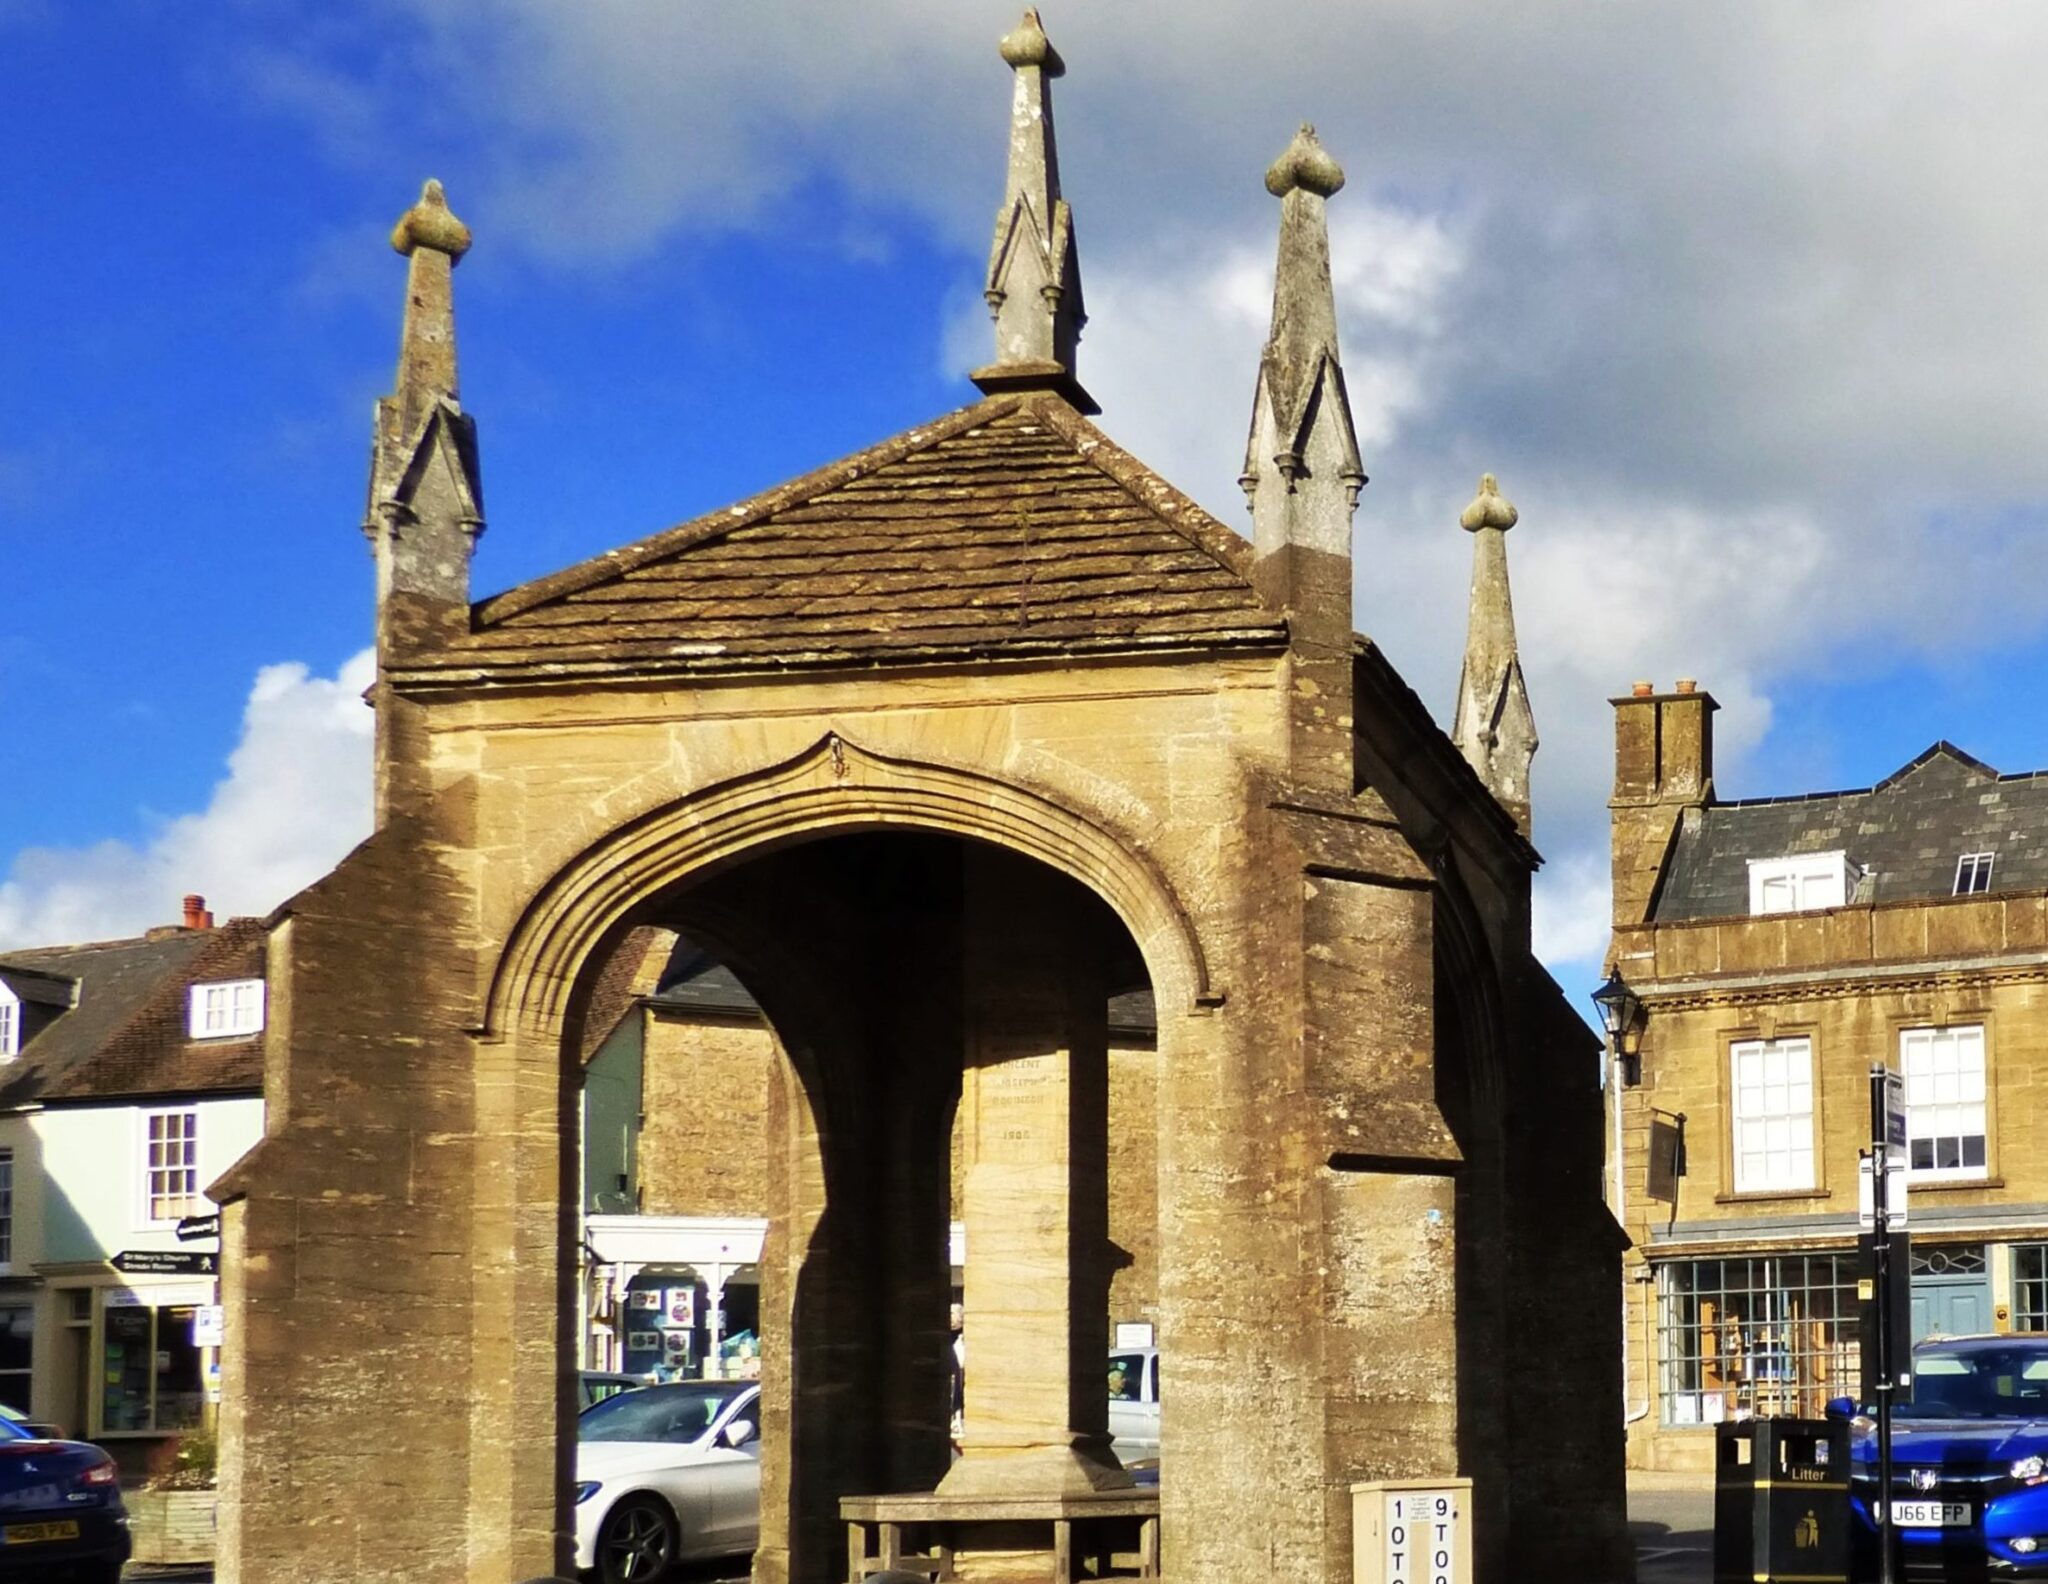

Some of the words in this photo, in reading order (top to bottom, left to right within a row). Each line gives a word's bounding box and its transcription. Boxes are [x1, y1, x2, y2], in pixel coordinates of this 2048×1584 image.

[134, 1254, 161, 1262] Mary's
[163, 1254, 191, 1262] Church
[1792, 1466, 1826, 1481] Litter
[1892, 1504, 1926, 1522] J66
[1930, 1504, 1965, 1522] EFP
